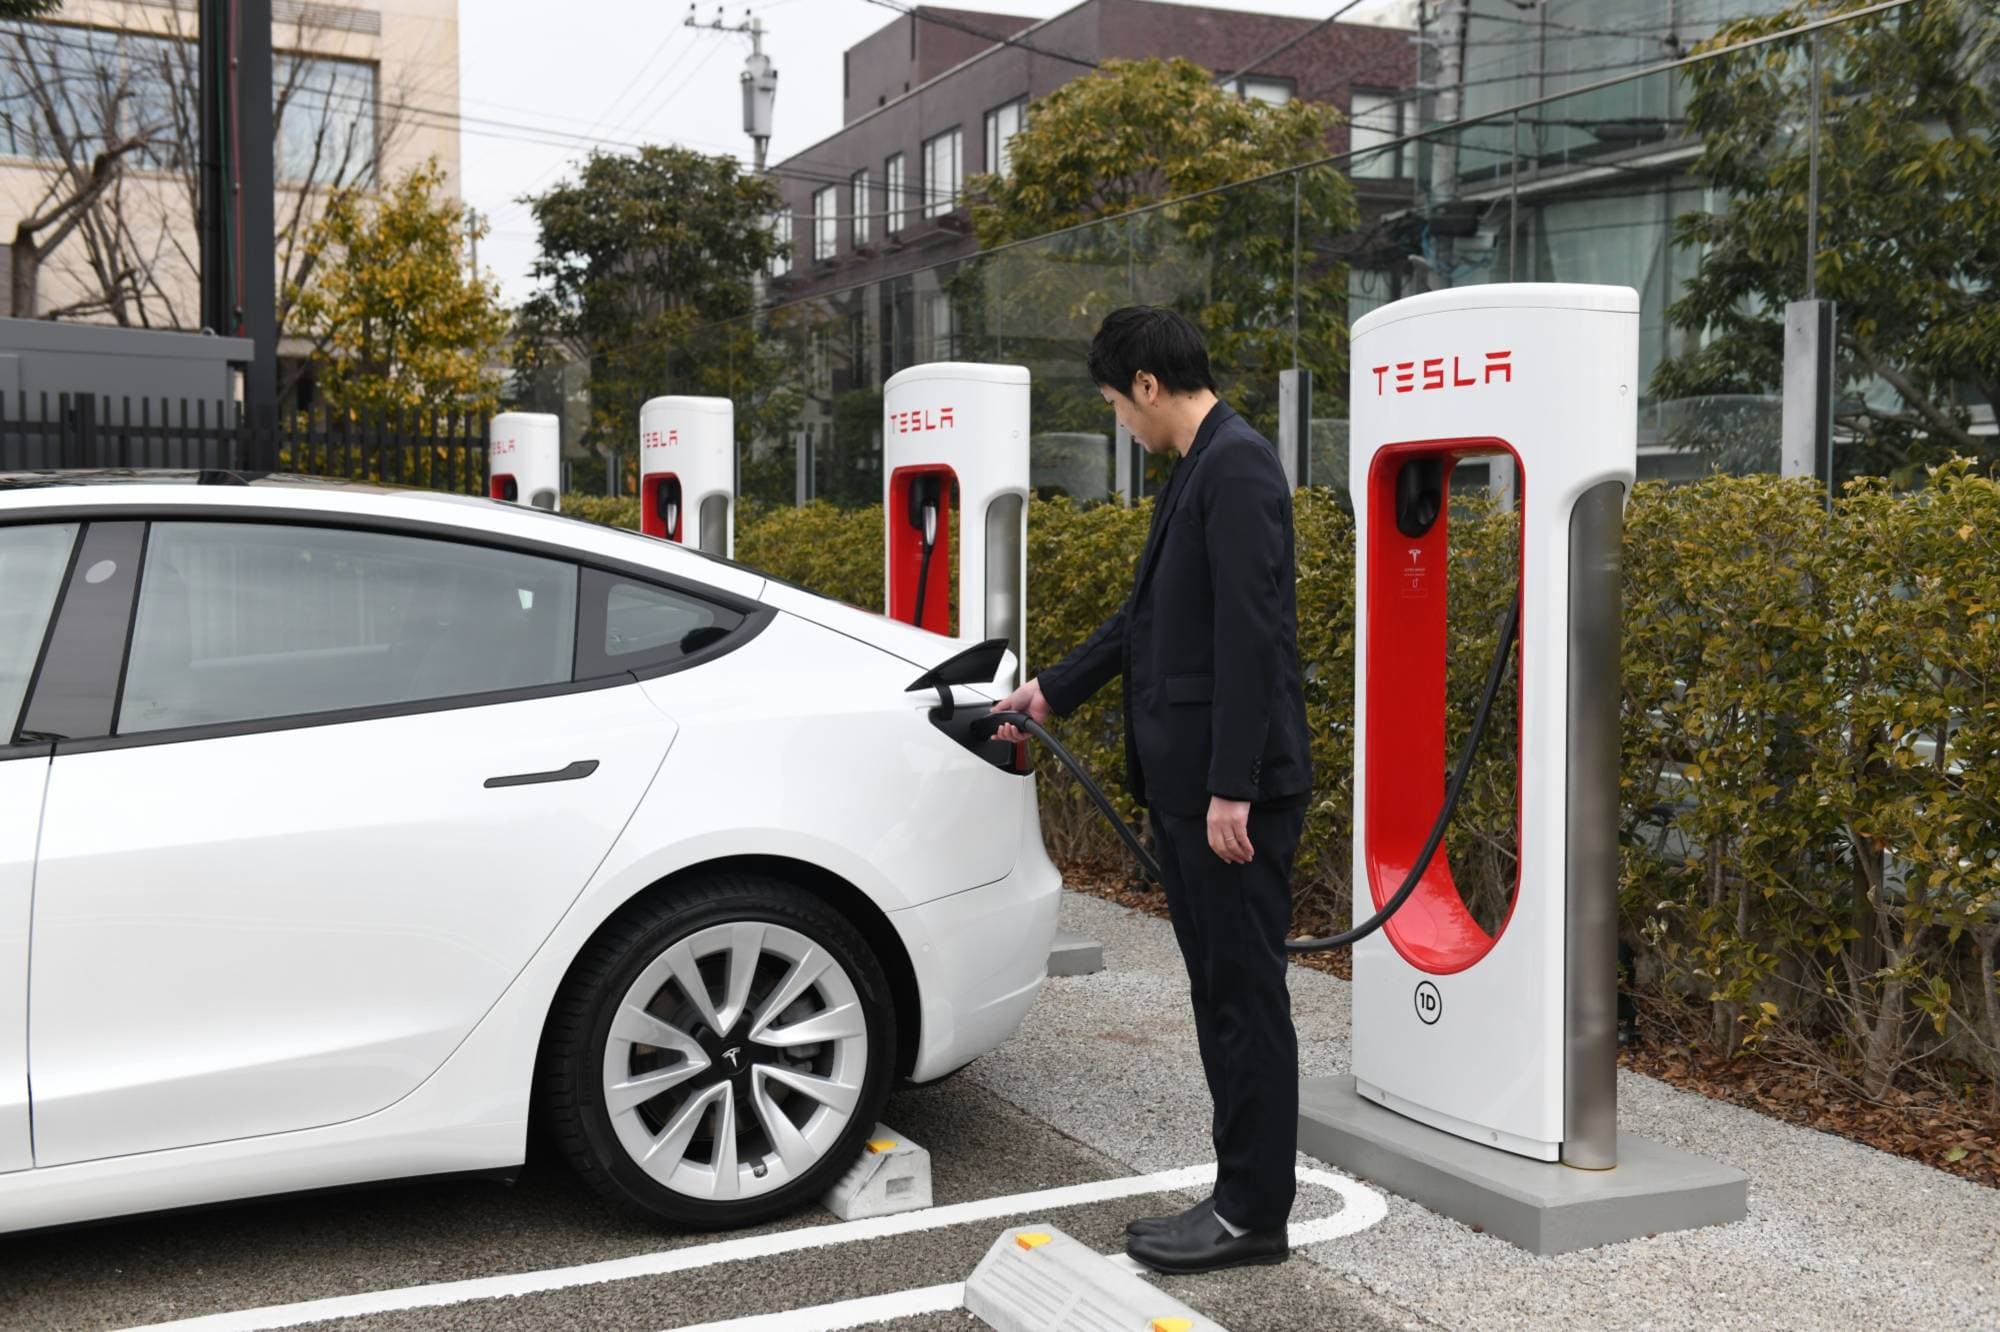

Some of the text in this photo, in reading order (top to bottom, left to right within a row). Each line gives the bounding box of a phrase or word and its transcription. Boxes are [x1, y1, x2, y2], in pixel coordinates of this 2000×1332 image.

[1371, 350, 1513, 396] TESLA
[890, 407, 954, 435] TESLA
[1419, 992, 1436, 1011] 1D
